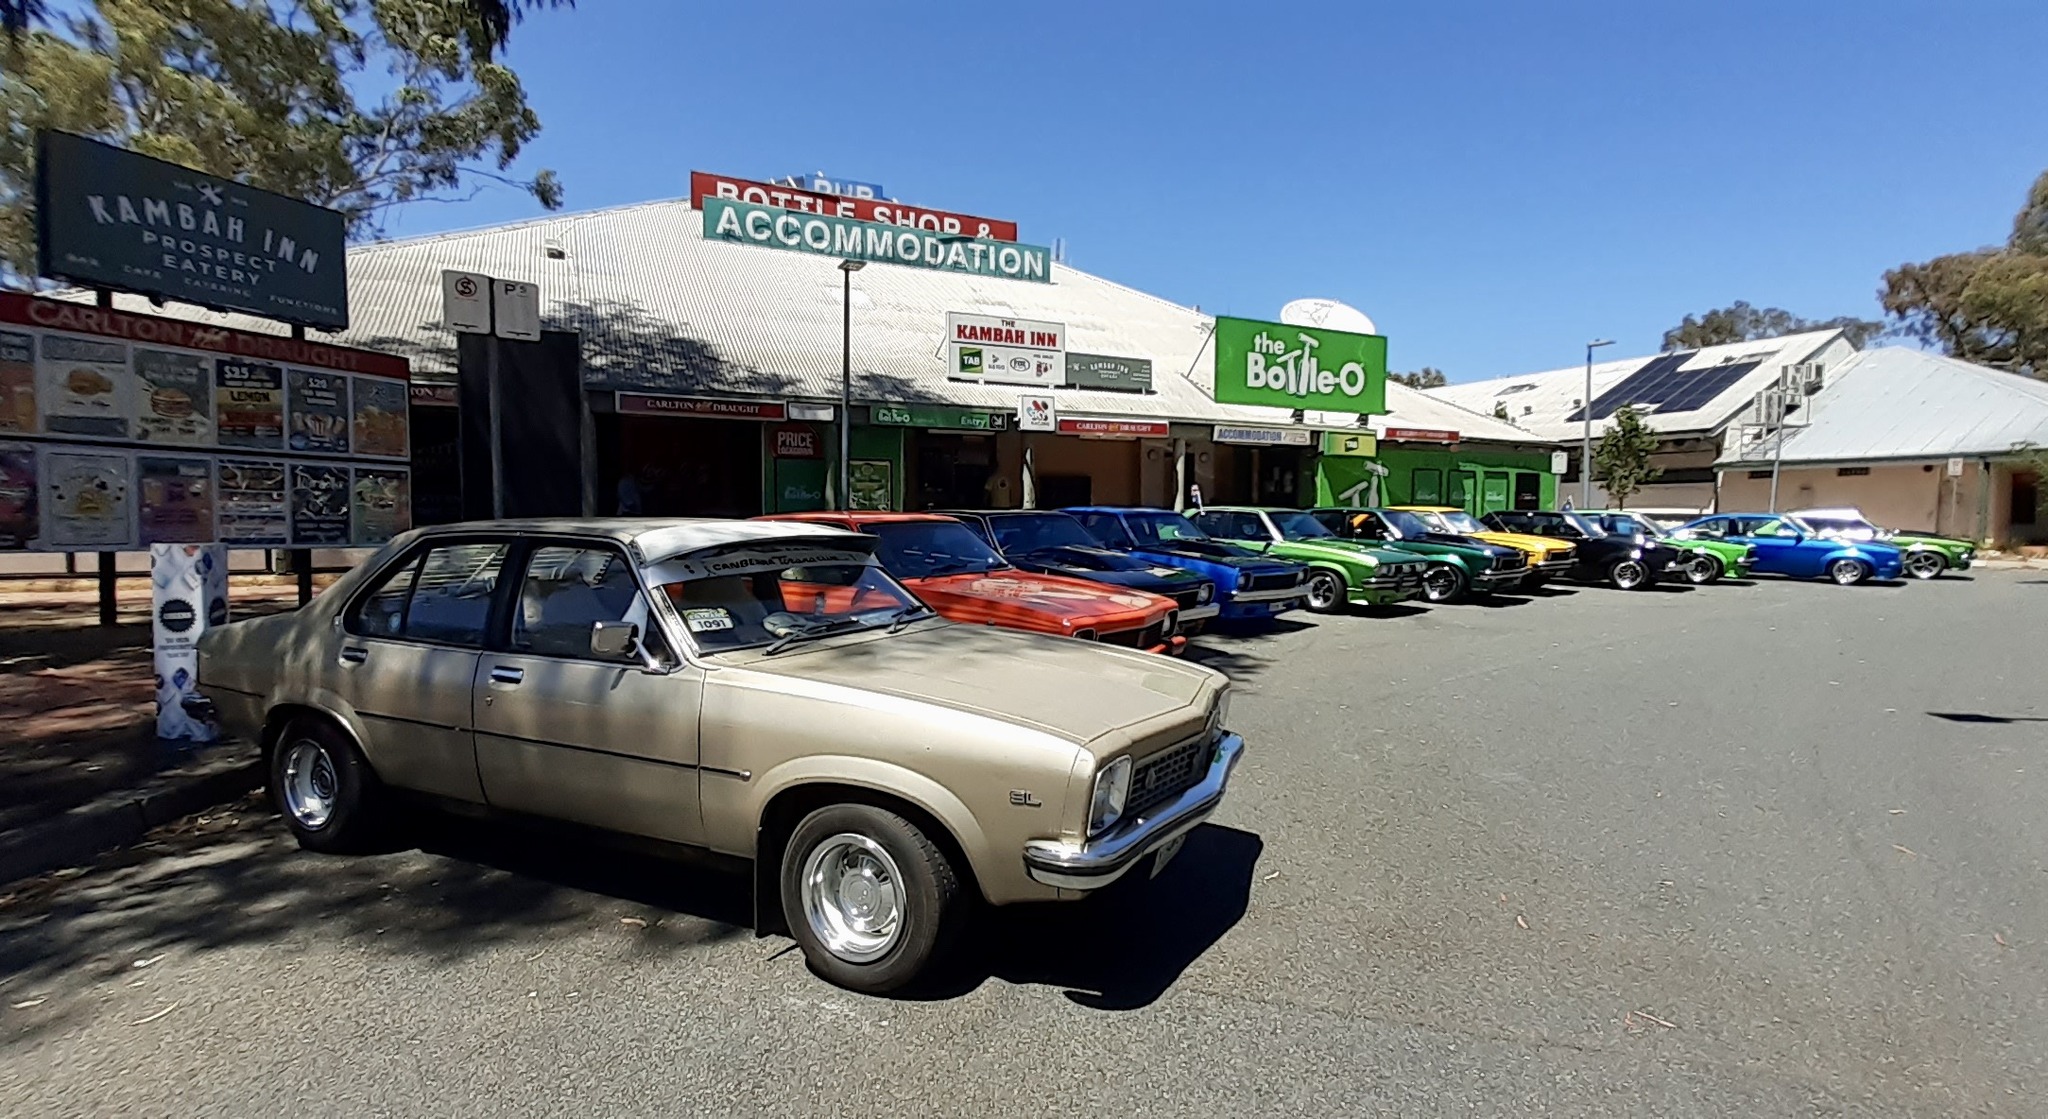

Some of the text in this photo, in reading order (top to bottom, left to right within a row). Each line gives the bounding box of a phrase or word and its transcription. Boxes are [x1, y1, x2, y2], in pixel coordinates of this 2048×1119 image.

[873, 206, 961, 235] SHOP
[87, 194, 320, 274] KAMBAH INN
[716, 206, 1044, 278] ACCOMMODATION
[143, 229, 277, 273] PROSPECT
[162, 253, 261, 286] EATERY
[184, 277, 251, 297] CATERING
[269, 295, 338, 315] FUNCTIONS
[28, 300, 357, 368] CARLTON DRAUGHT
[1001, 319, 1016, 328] THE
[956, 324, 1058, 348] KAMBAH INN
[1253, 331, 1286, 355] the
[962, 356, 980, 366] TAB
[647, 400, 760, 414] CARLTON DRAUGHT
[961, 416, 986, 429] Entry
[777, 431, 814, 447] PRICE
[697, 619, 727, 629] 1091
[1009, 789, 1042, 808] SL
